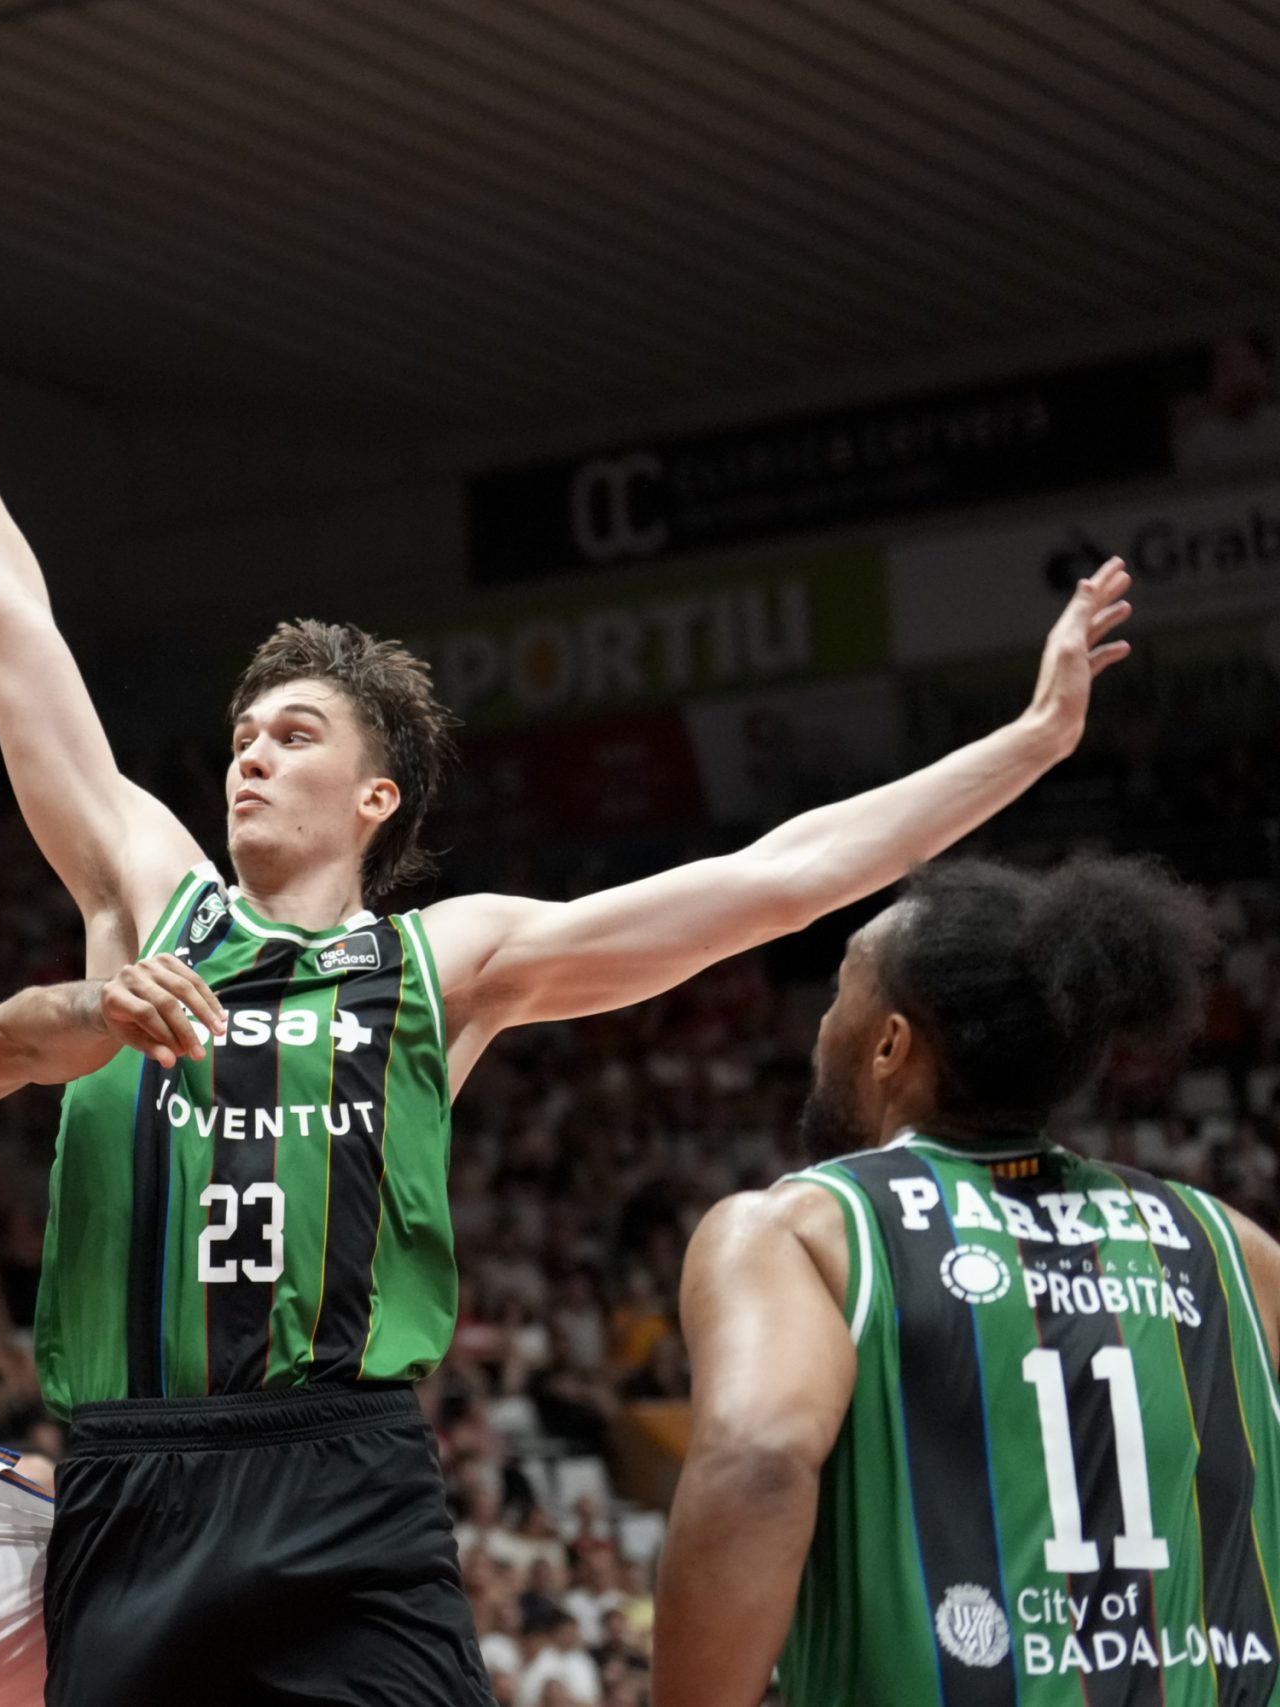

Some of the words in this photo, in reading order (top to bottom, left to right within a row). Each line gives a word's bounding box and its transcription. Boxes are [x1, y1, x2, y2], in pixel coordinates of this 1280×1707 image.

[423, 578, 812, 718] PORTIU
[323, 954, 376, 968] endesa
[156, 1079, 374, 1140] JOVENTUT
[198, 1182, 286, 1283] 23
[888, 1176, 1191, 1250] PARKER
[1023, 1268, 1201, 1328] PROBITAS
[1021, 1346, 1170, 1573] 11
[1017, 1586, 1088, 1631] City
[1101, 1583, 1138, 1621] of
[1023, 1624, 1272, 1676] BADALONA
